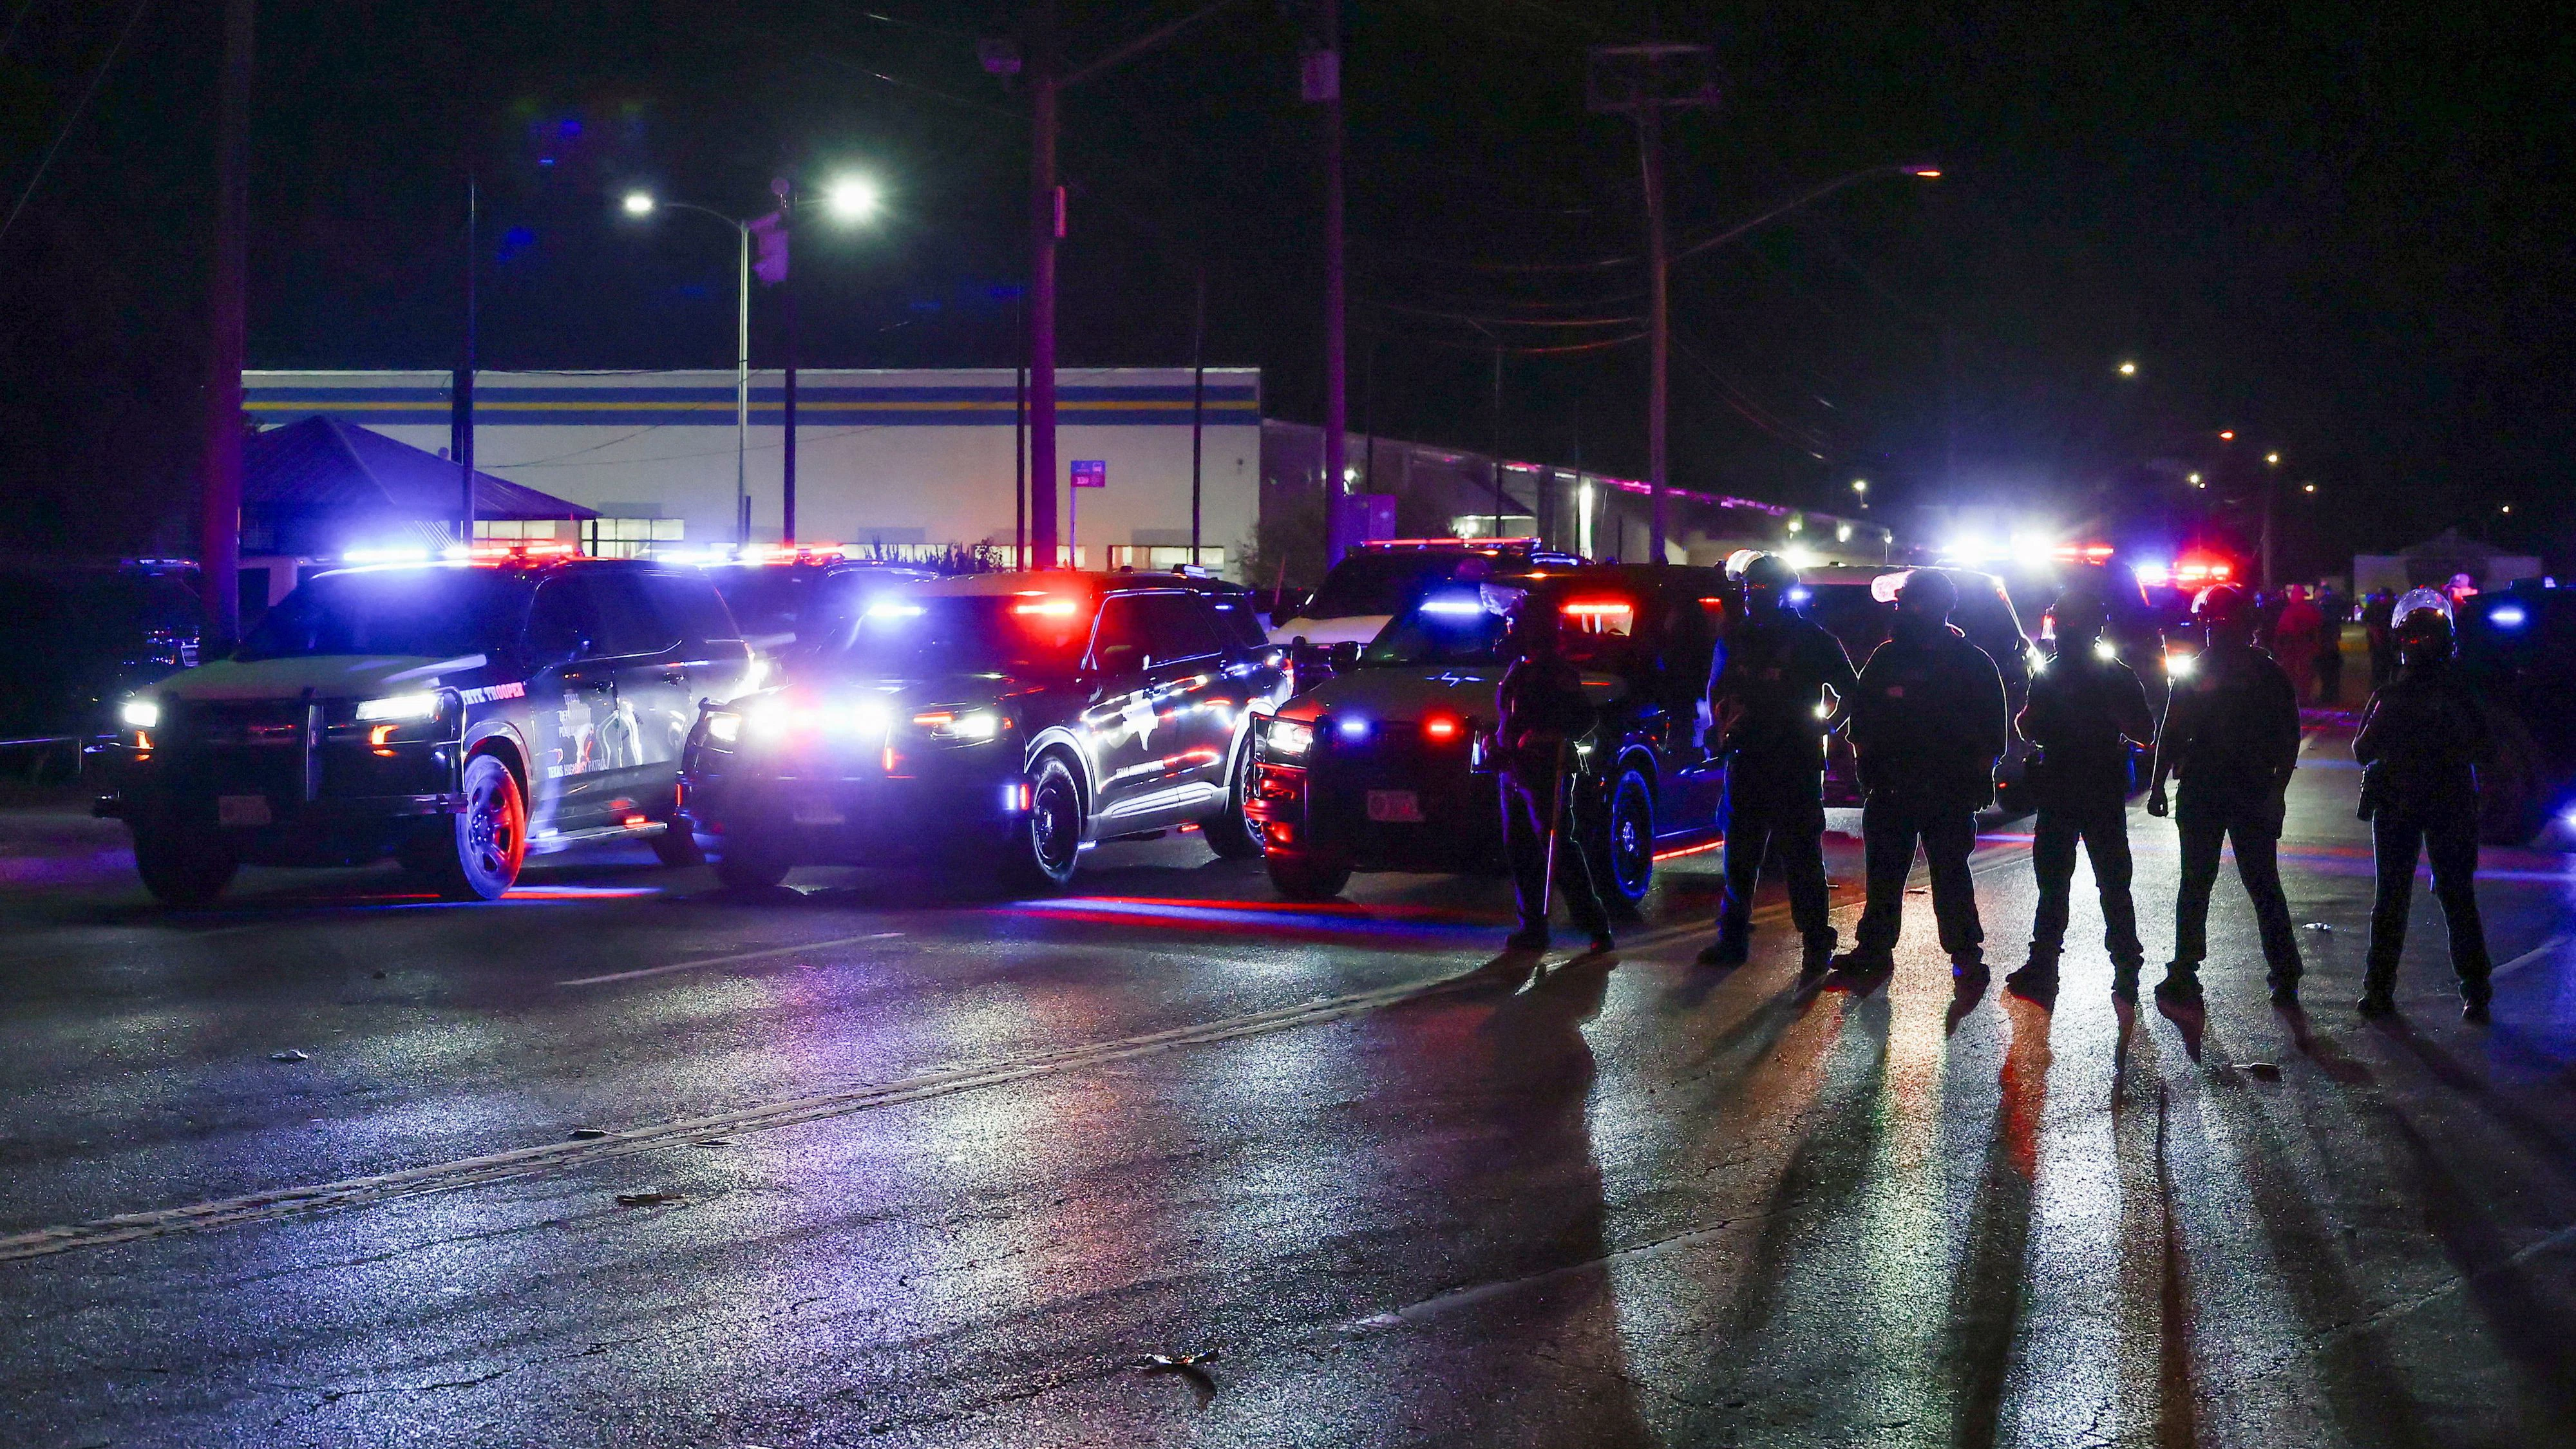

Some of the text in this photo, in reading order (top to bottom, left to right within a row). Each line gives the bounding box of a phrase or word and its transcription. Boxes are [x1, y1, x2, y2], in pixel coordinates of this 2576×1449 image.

[459, 681, 525, 705] TATE TROOPER
[547, 765, 564, 779] TEXAS
[564, 761, 587, 776] HIGHWAY
